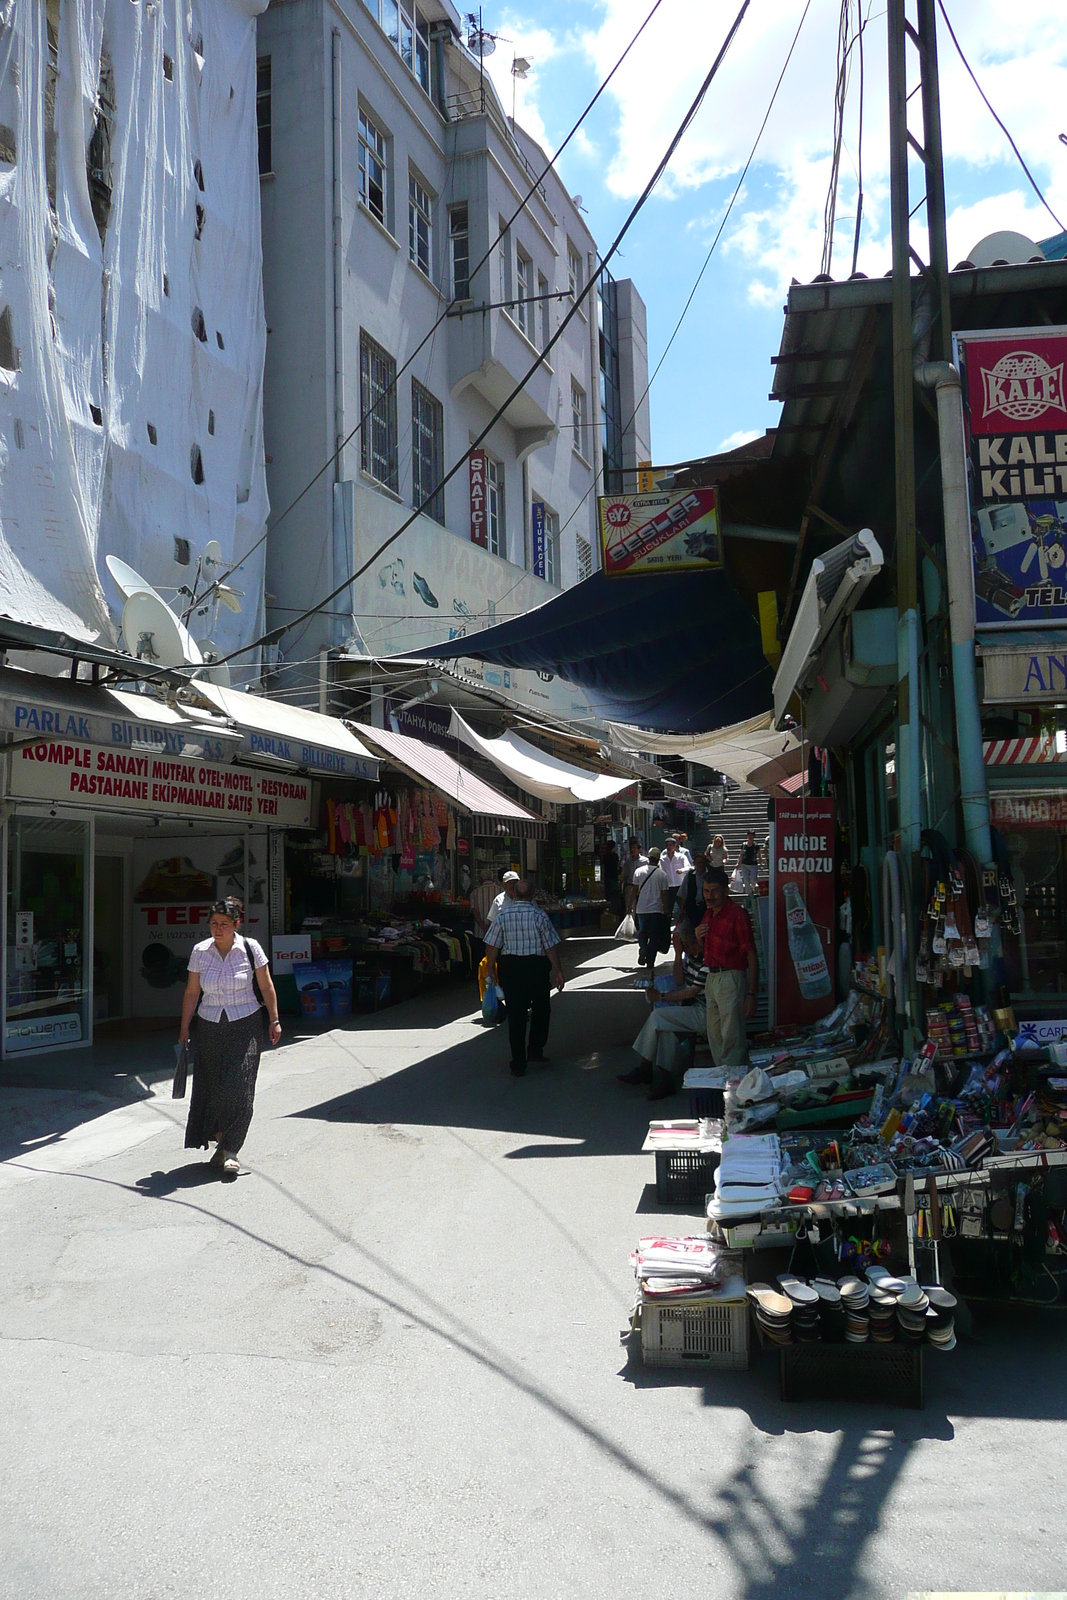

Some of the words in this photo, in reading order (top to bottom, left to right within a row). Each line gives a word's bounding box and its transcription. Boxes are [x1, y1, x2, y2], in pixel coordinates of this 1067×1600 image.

[987, 370, 1060, 409] KALE
[471, 458, 483, 538] SAATÇİ
[609, 507, 630, 523] BYZ
[633, 518, 690, 560] SUCUKLARI
[15, 706, 90, 739] PARLAK
[22, 743, 91, 769] KOMPLE
[97, 752, 149, 777] SANAYİ
[152, 760, 195, 783] MUTFAK
[250, 733, 291, 759] PARLAK
[302, 745, 346, 772] BİLLURİYE
[70, 771, 148, 800] PASTAHANE
[152, 782, 224, 810] EKİPMANLARI
[227, 793, 253, 816] SATIŞ
[256, 797, 278, 816] YERİ
[783, 834, 827, 851] NİĞDE
[778, 857, 833, 873] GAZOZU
[149, 931, 162, 939] Ne
[166, 931, 195, 939] varsa
[274, 950, 310, 960] Tefal
